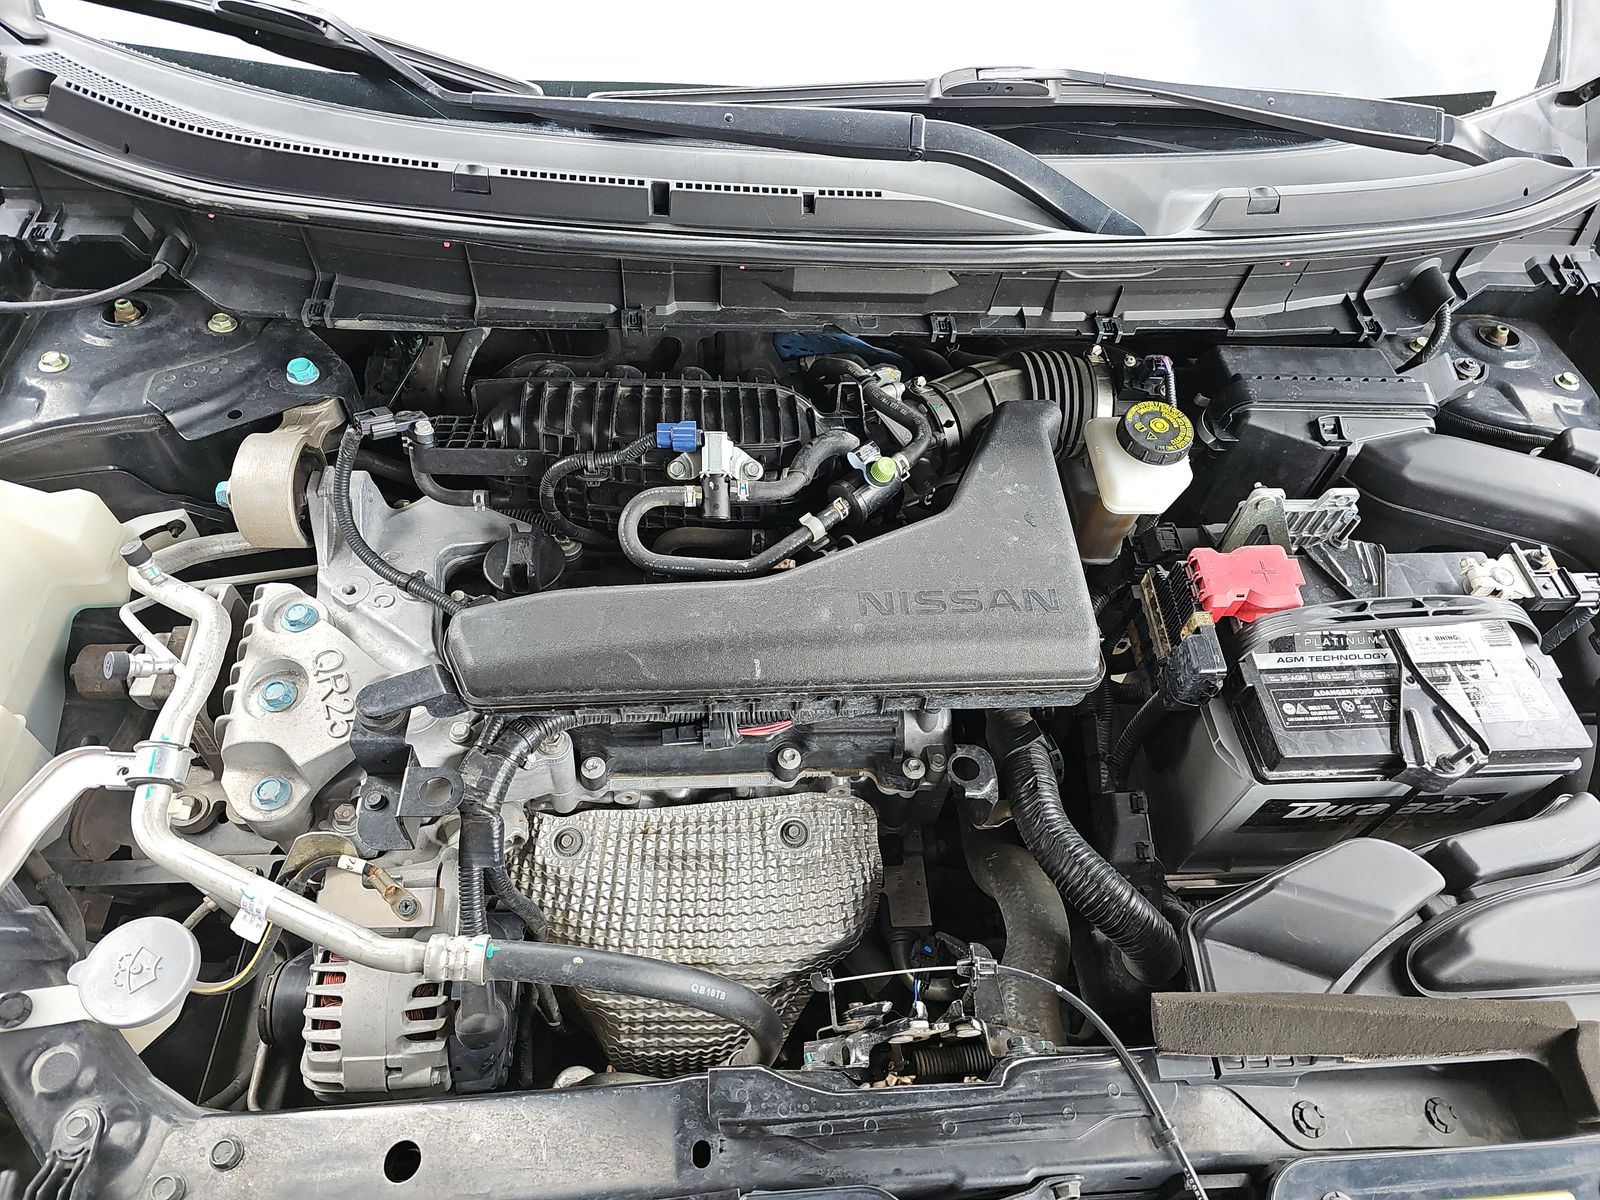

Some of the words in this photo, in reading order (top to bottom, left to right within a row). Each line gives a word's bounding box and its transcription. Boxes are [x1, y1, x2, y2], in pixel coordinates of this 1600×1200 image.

[858, 588, 1061, 616] NISSAN
[1304, 636, 1378, 647] PLATINUM
[1277, 656, 1305, 664] AGM
[1308, 652, 1389, 662] TECHNOLOGY
[312, 649, 355, 738] QR25
[1320, 687, 1384, 696] DANGER/POISON
[1282, 797, 1474, 821] Duraast
